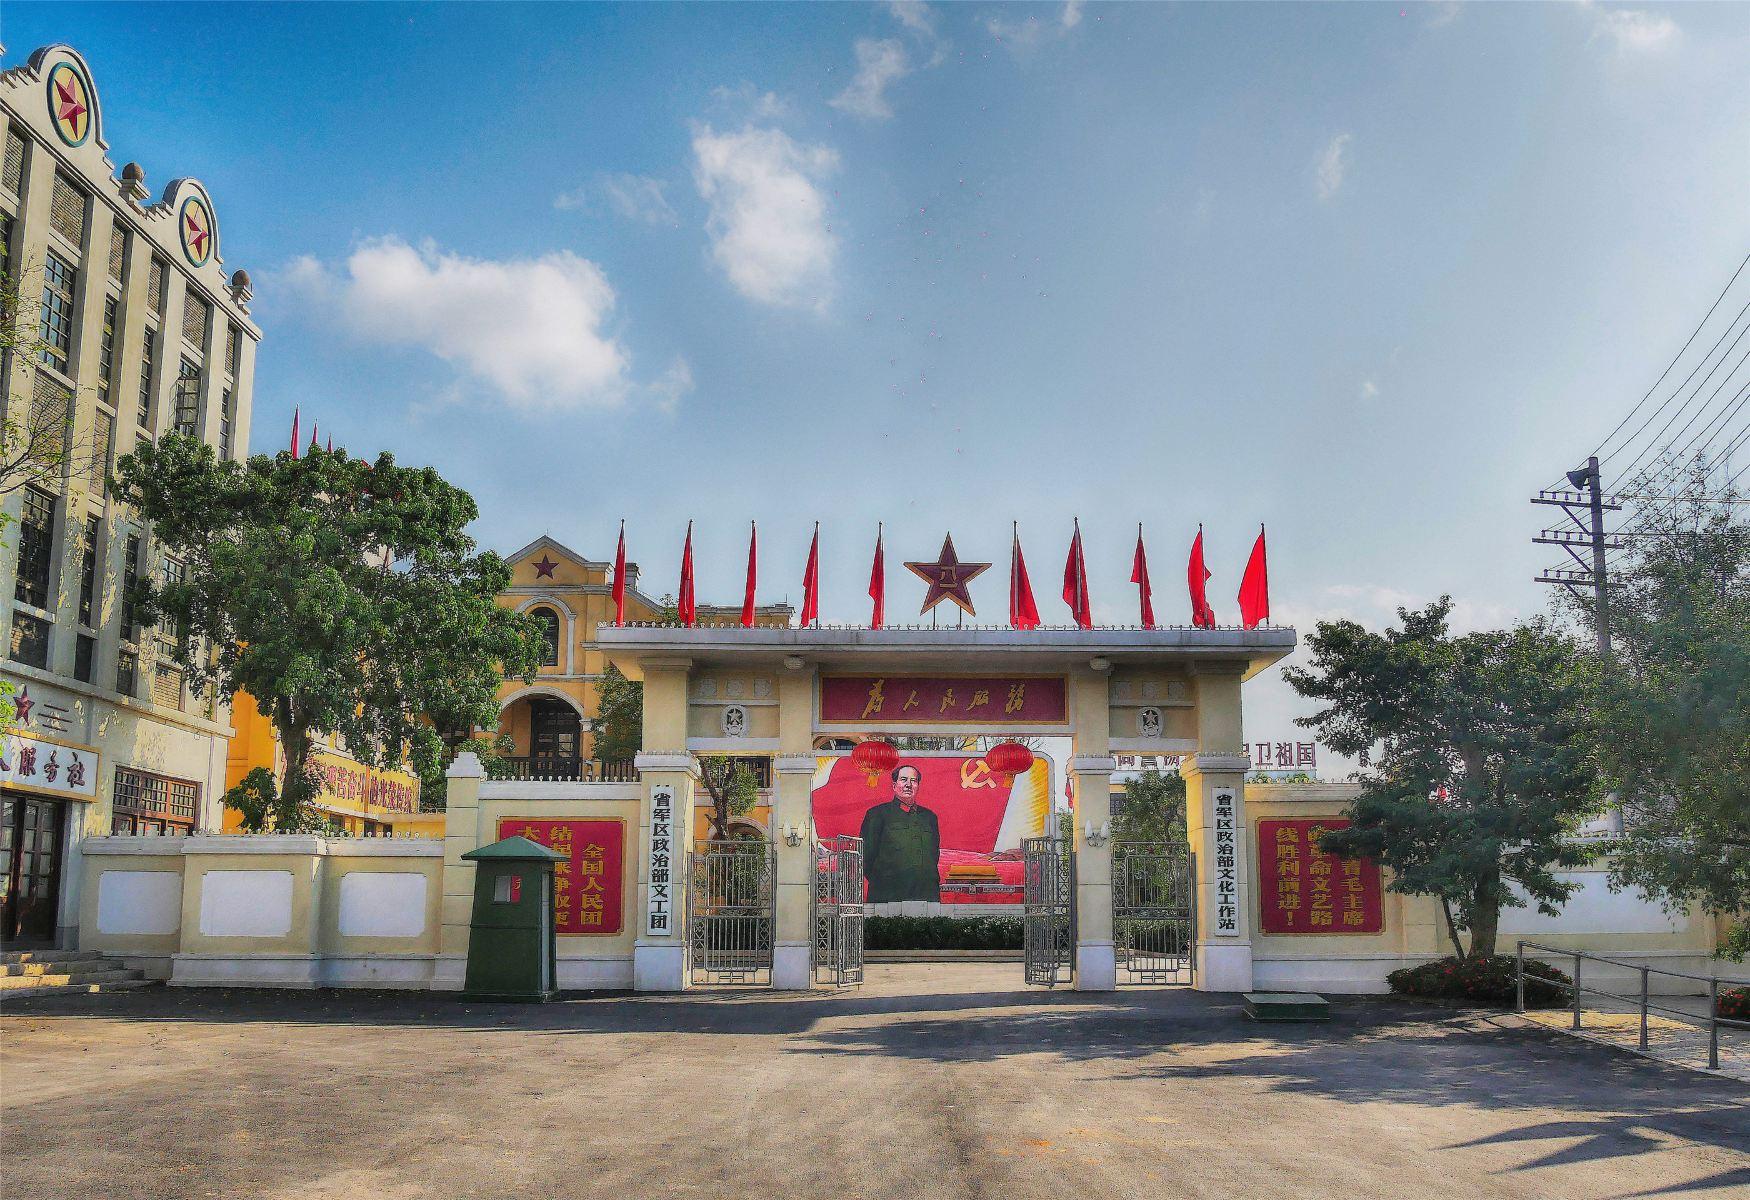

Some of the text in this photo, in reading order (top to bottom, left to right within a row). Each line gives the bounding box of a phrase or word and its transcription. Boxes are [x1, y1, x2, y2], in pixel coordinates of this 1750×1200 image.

[0, 747, 86, 788] 服务社
[1244, 741, 1316, 768] 卫祖国
[581, 844, 605, 926] 全国人民团
[650, 793, 671, 930] 省军区政治部文工团
[1216, 794, 1236, 930] 省军区政治部文化工作站
